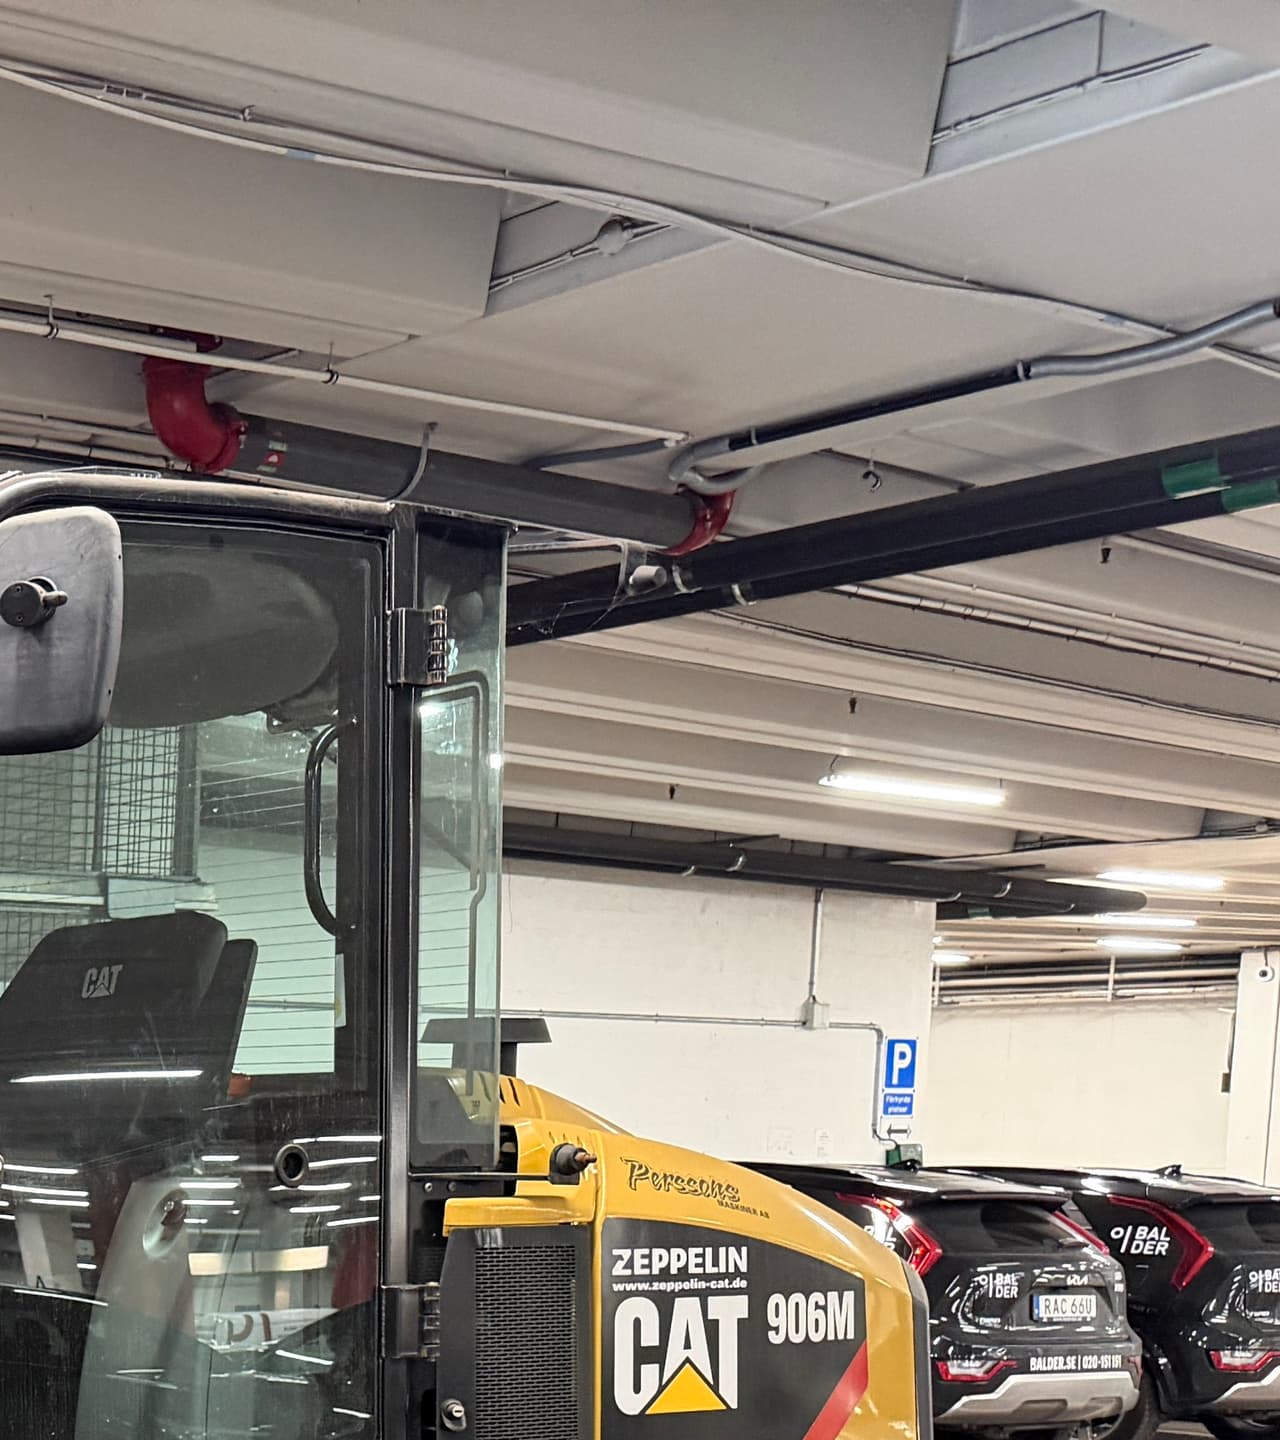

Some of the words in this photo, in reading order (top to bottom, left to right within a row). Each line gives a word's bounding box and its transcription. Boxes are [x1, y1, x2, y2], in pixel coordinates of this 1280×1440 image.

[81, 964, 124, 999] CAT
[891, 1043, 913, 1086] P
[620, 1156, 741, 1203] Perssons
[1134, 1226, 1171, 1241] BAL
[1130, 1240, 1170, 1256] DER
[611, 1246, 748, 1277] ZEPPELIN
[612, 1277, 748, 1293] www.zeppelin-cat.de
[995, 1272, 1018, 1286] BAL
[995, 1286, 1018, 1299] DER
[1044, 1297, 1067, 1316] RAC
[1070, 1296, 1093, 1315] 66U
[766, 1290, 855, 1345] 906M
[613, 1294, 749, 1416] CAT
[1029, 1355, 1077, 1371] BALDER.SE
